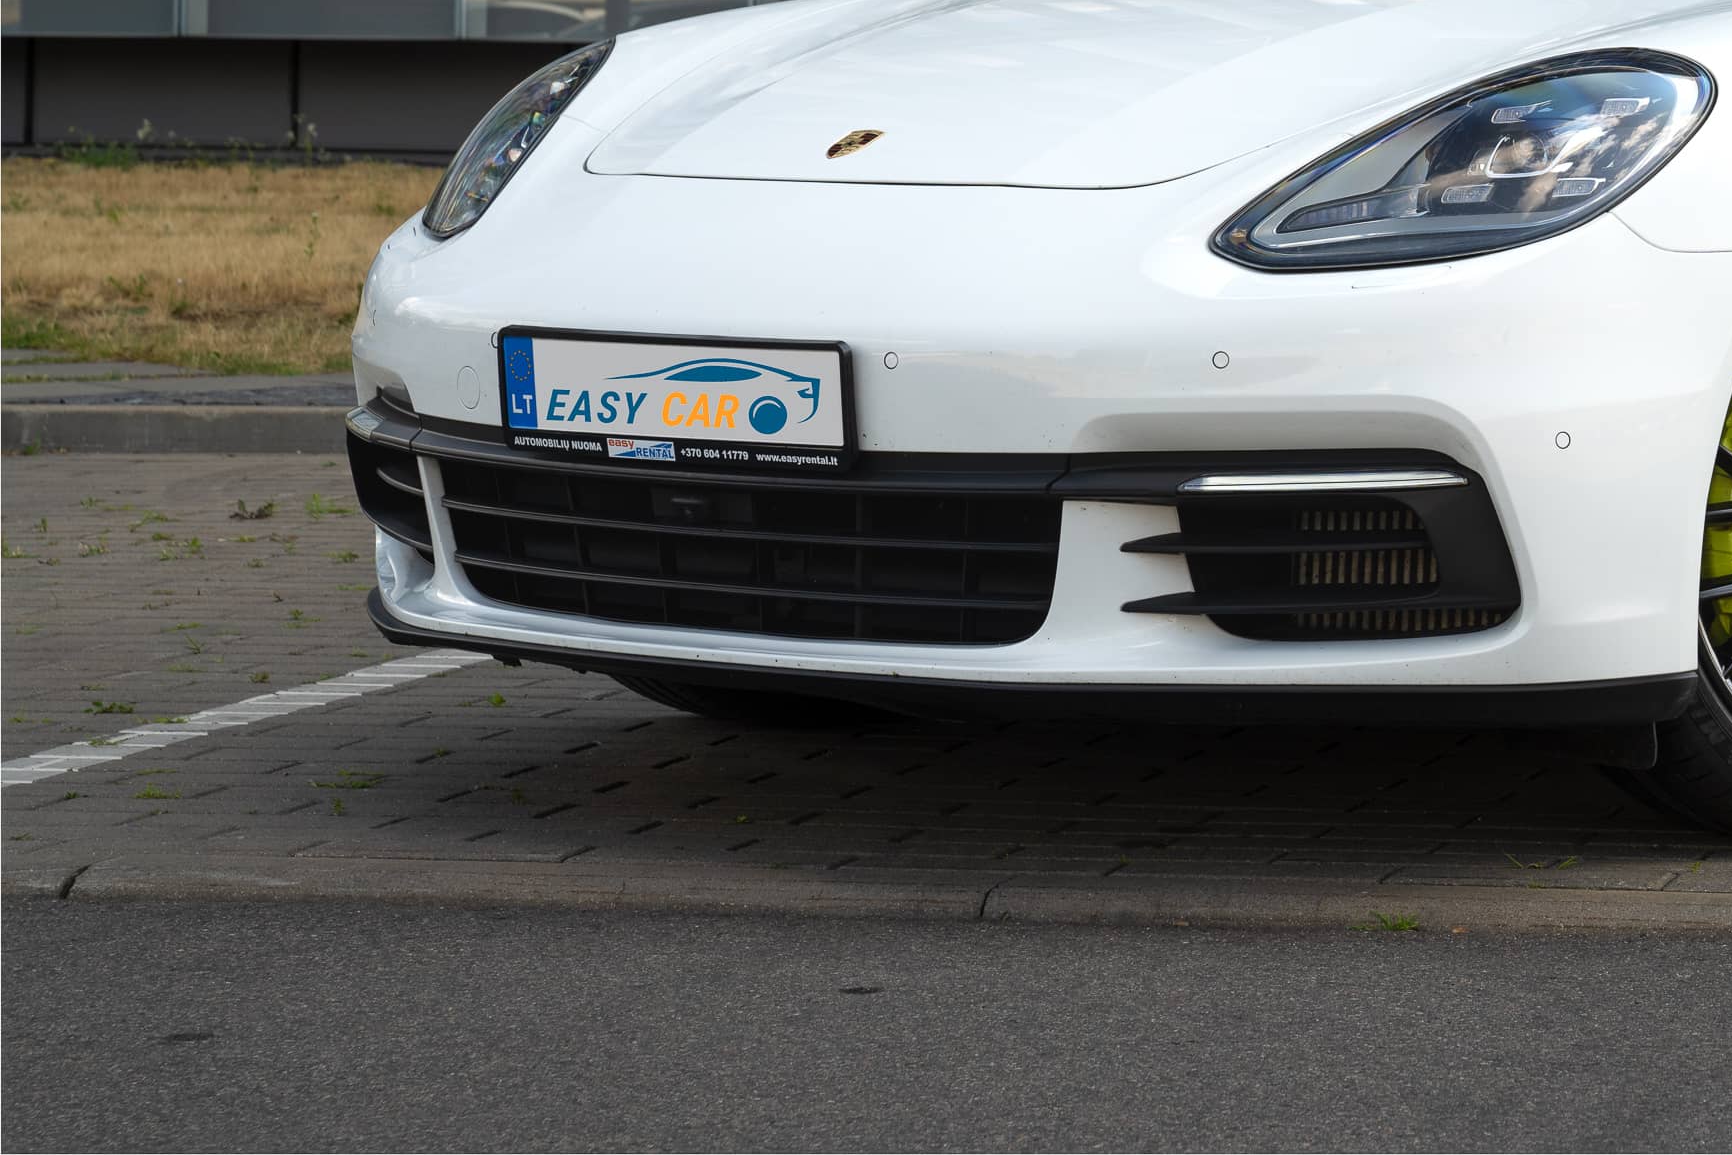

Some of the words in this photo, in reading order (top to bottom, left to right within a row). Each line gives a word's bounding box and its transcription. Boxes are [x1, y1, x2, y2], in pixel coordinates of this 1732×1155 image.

[511, 393, 533, 416] LT
[546, 389, 649, 425] EASY
[661, 391, 740, 429] CAR
[514, 435, 570, 452] AUTOMOBILIŲ
[571, 440, 603, 452] NUOMA
[607, 438, 634, 449] easy
[635, 447, 675, 459] RENTAL
[680, 447, 701, 458] +370
[703, 448, 720, 459] 604
[722, 450, 749, 461] 11779
[755, 452, 839, 466] www.easyrental.lt
